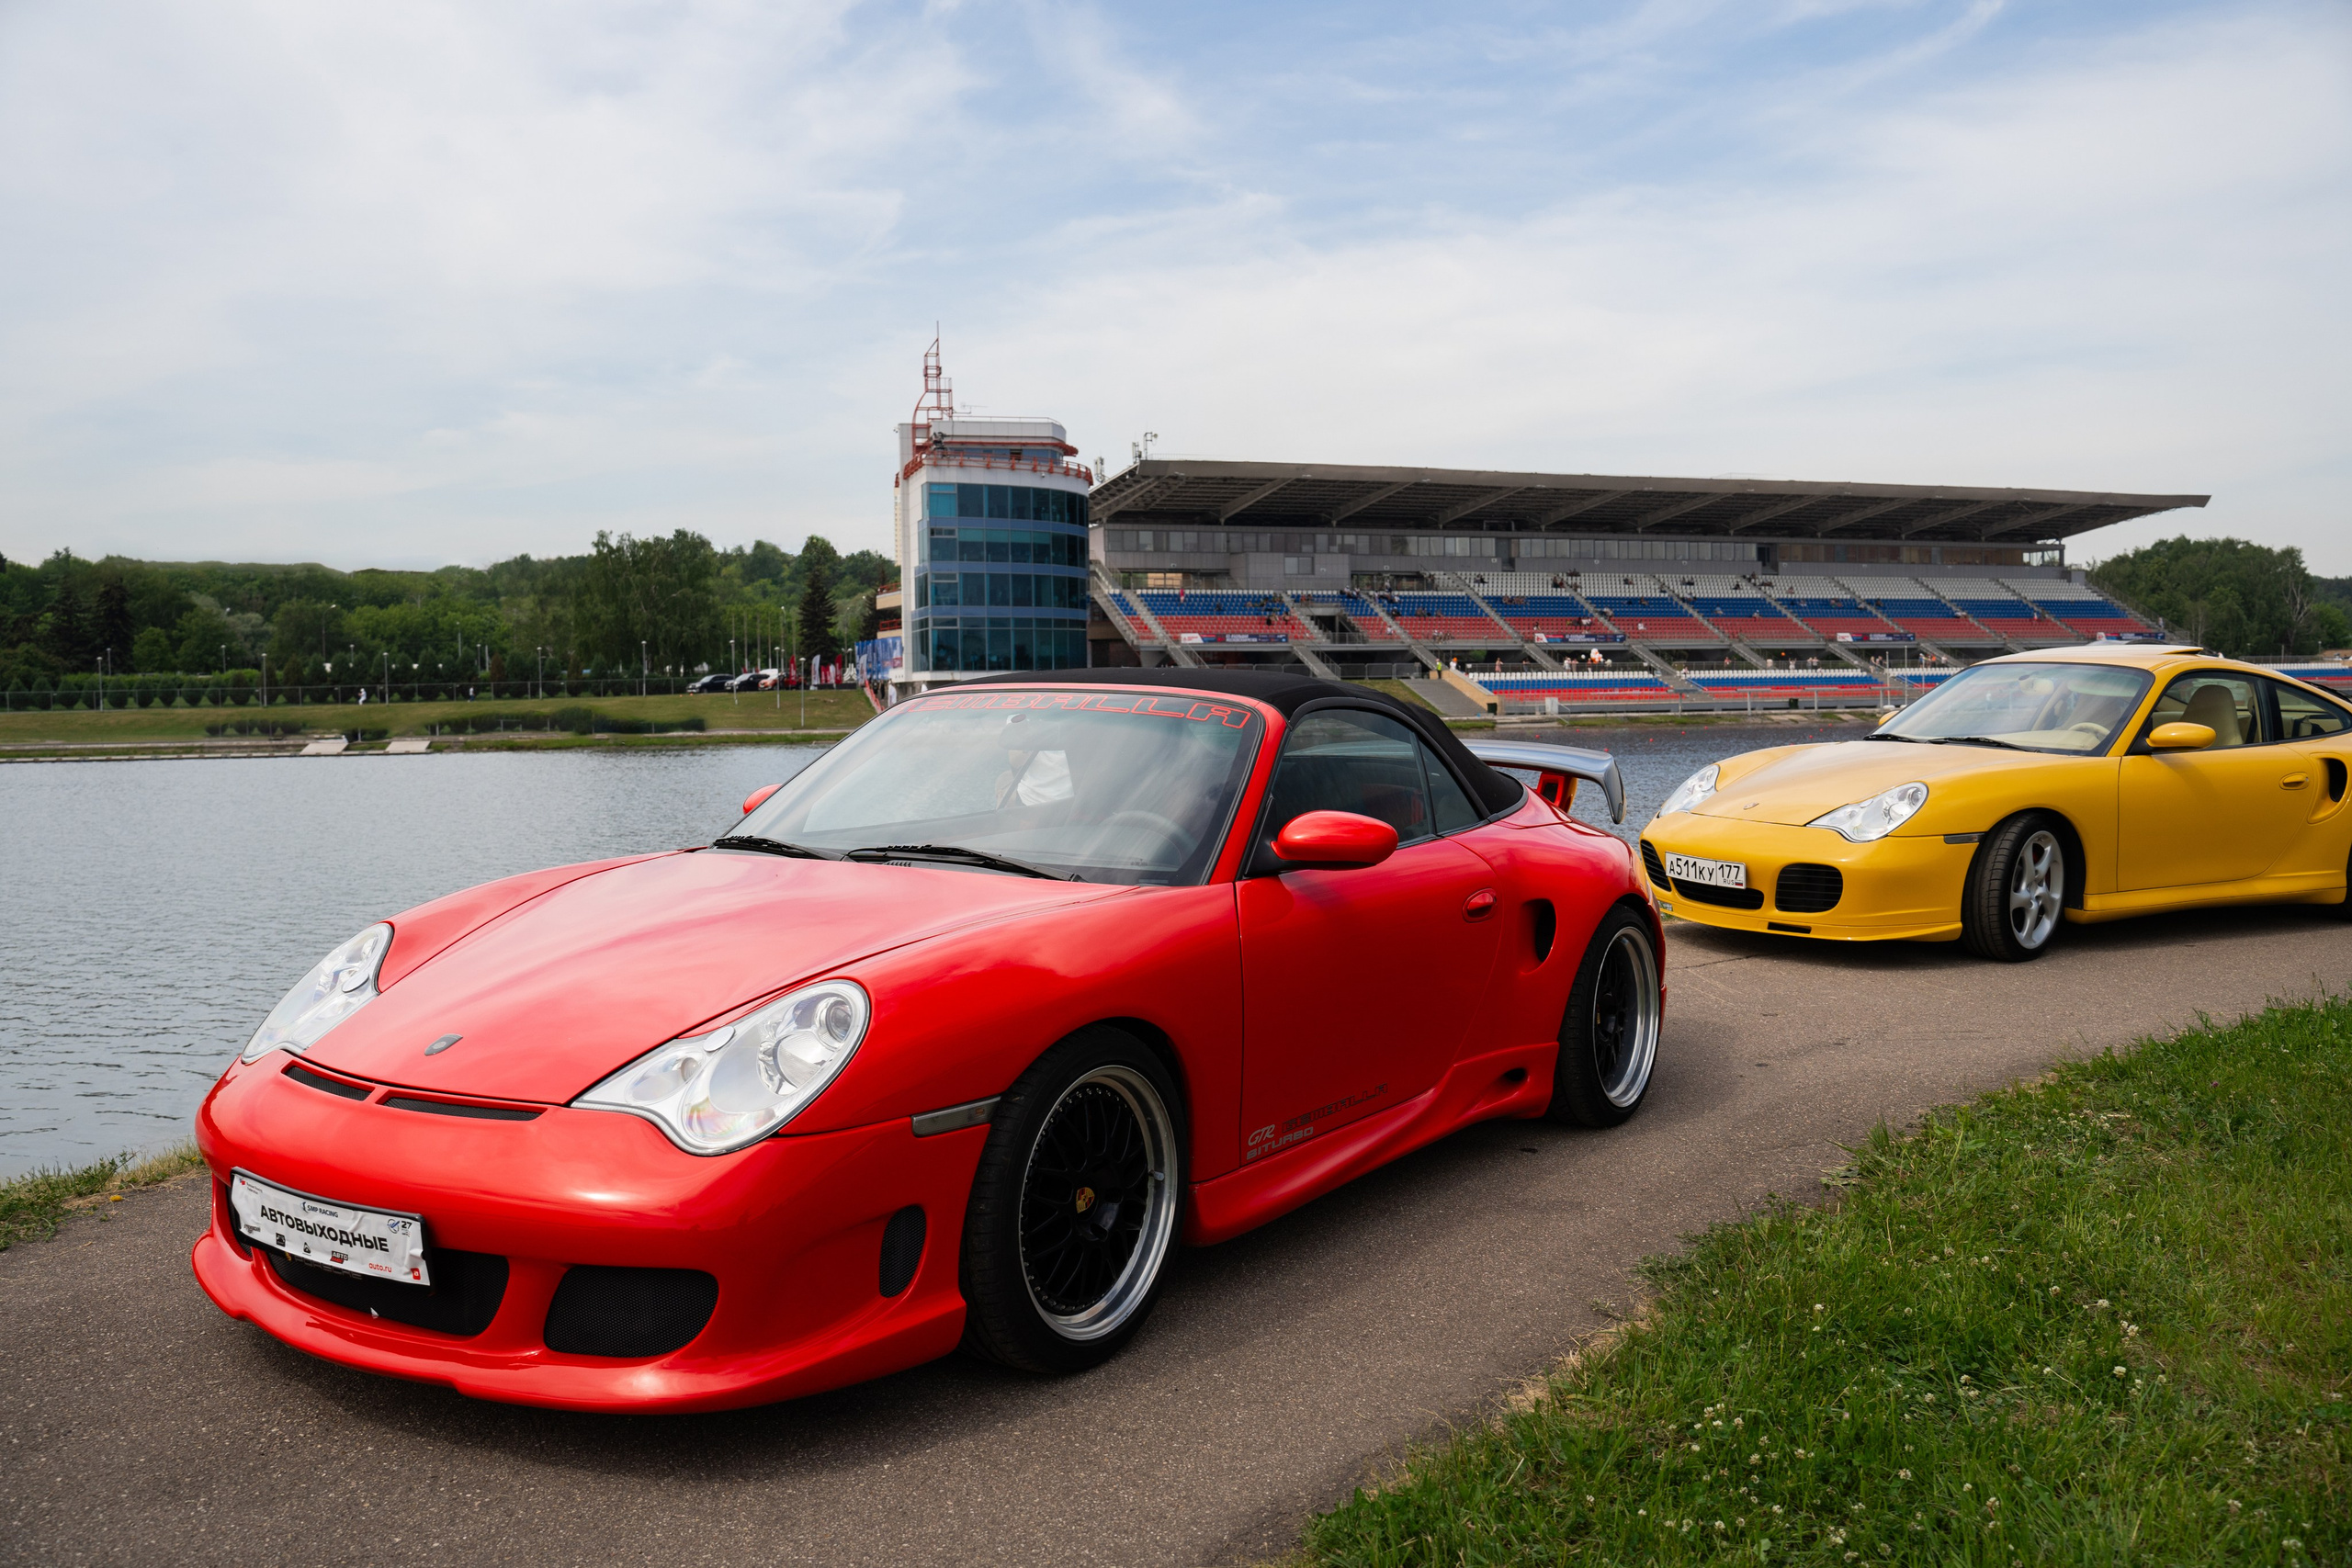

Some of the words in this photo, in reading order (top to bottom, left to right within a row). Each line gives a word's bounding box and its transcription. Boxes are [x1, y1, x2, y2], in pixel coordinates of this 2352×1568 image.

[1718, 863, 1740, 880] 177
[1247, 1126, 1314, 1160] BITURBO
[1248, 1124, 1275, 1146] GTR
[307, 1204, 318, 1213] SMP
[319, 1208, 339, 1218] RACING
[260, 1204, 390, 1253] АВТОВЫХОДНЫЕ
[401, 1220, 413, 1230] 27
[368, 1262, 392, 1273] auto.ru
